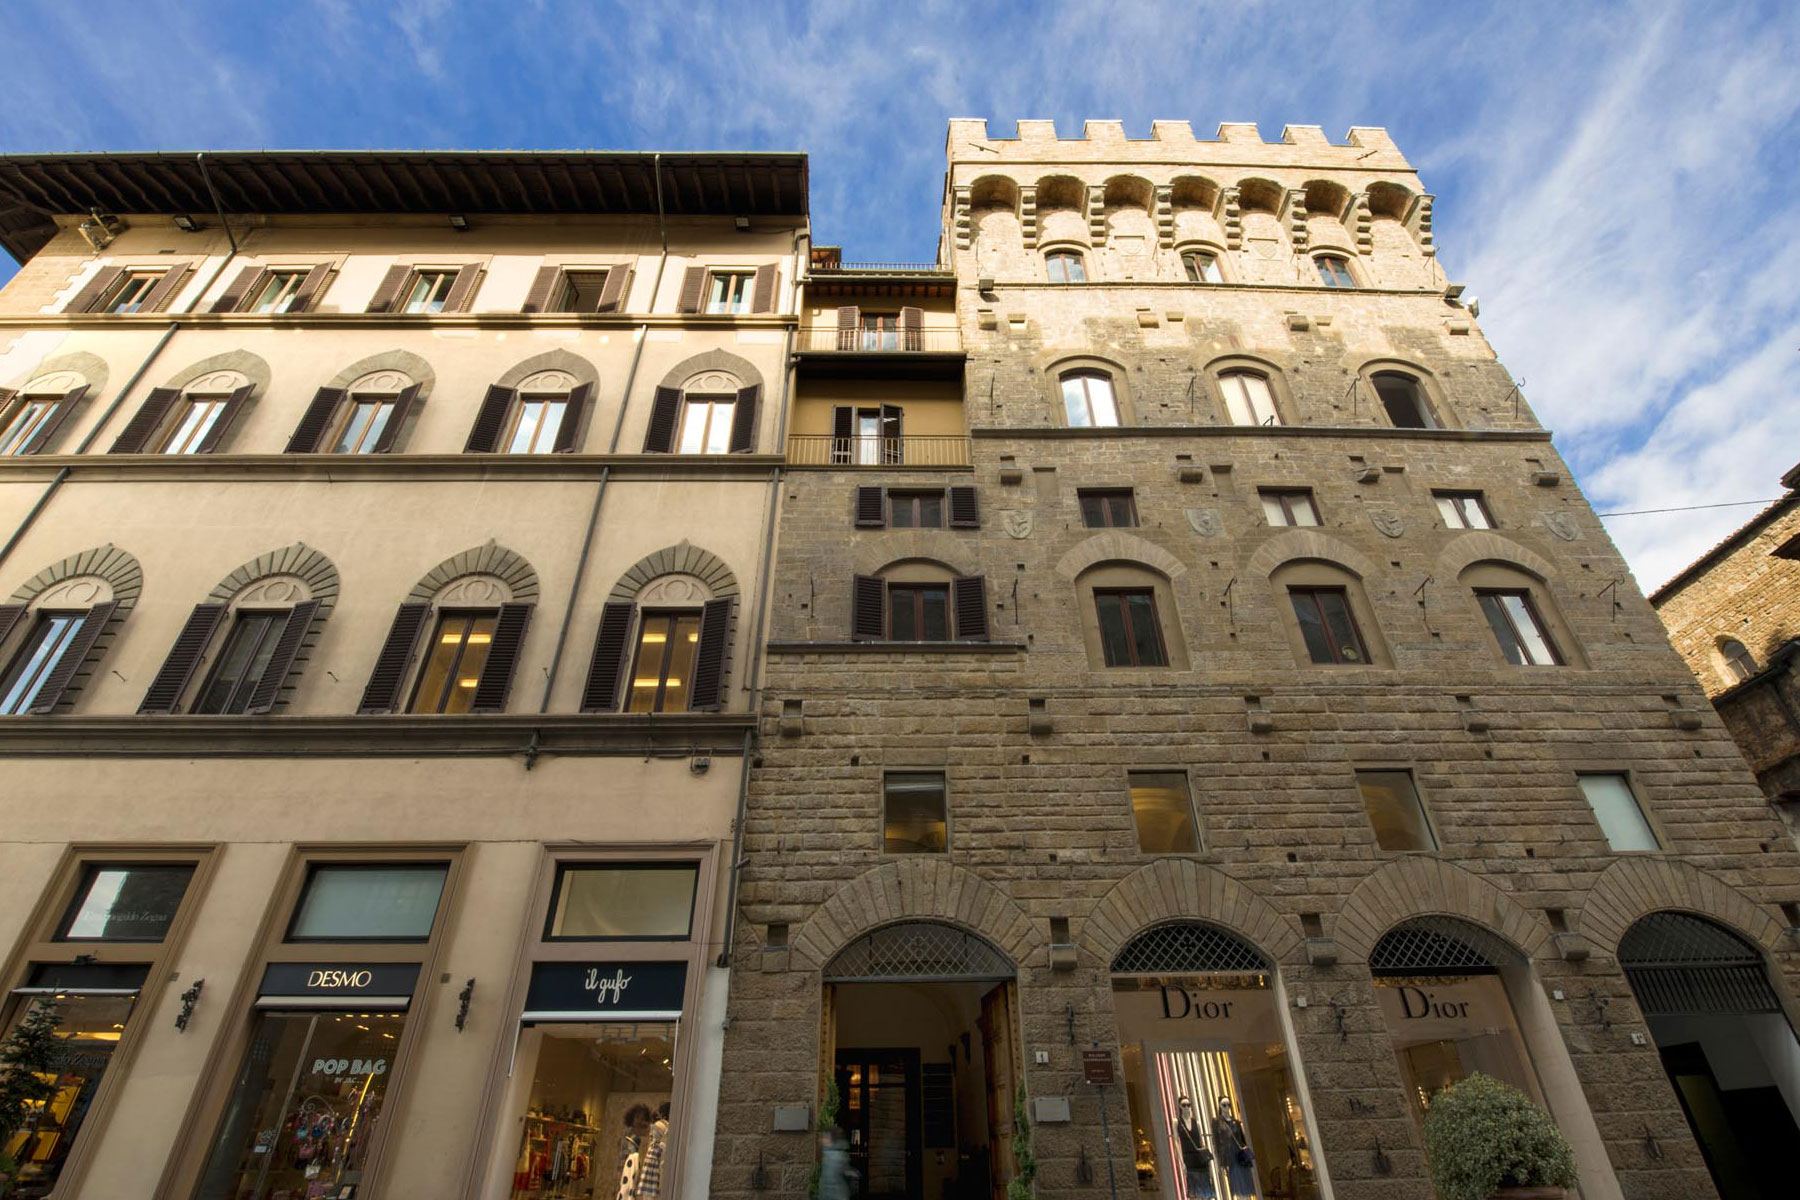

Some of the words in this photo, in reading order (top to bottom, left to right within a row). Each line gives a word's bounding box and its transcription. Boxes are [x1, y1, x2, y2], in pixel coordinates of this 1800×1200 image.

[307, 970, 372, 987] DESMO
[585, 968, 599, 990] il
[598, 969, 632, 1004] gufo
[1159, 985, 1233, 1019] Dior
[1397, 986, 1469, 1019] Dior
[311, 1059, 349, 1074] POP
[350, 1059, 386, 1074] BAG
